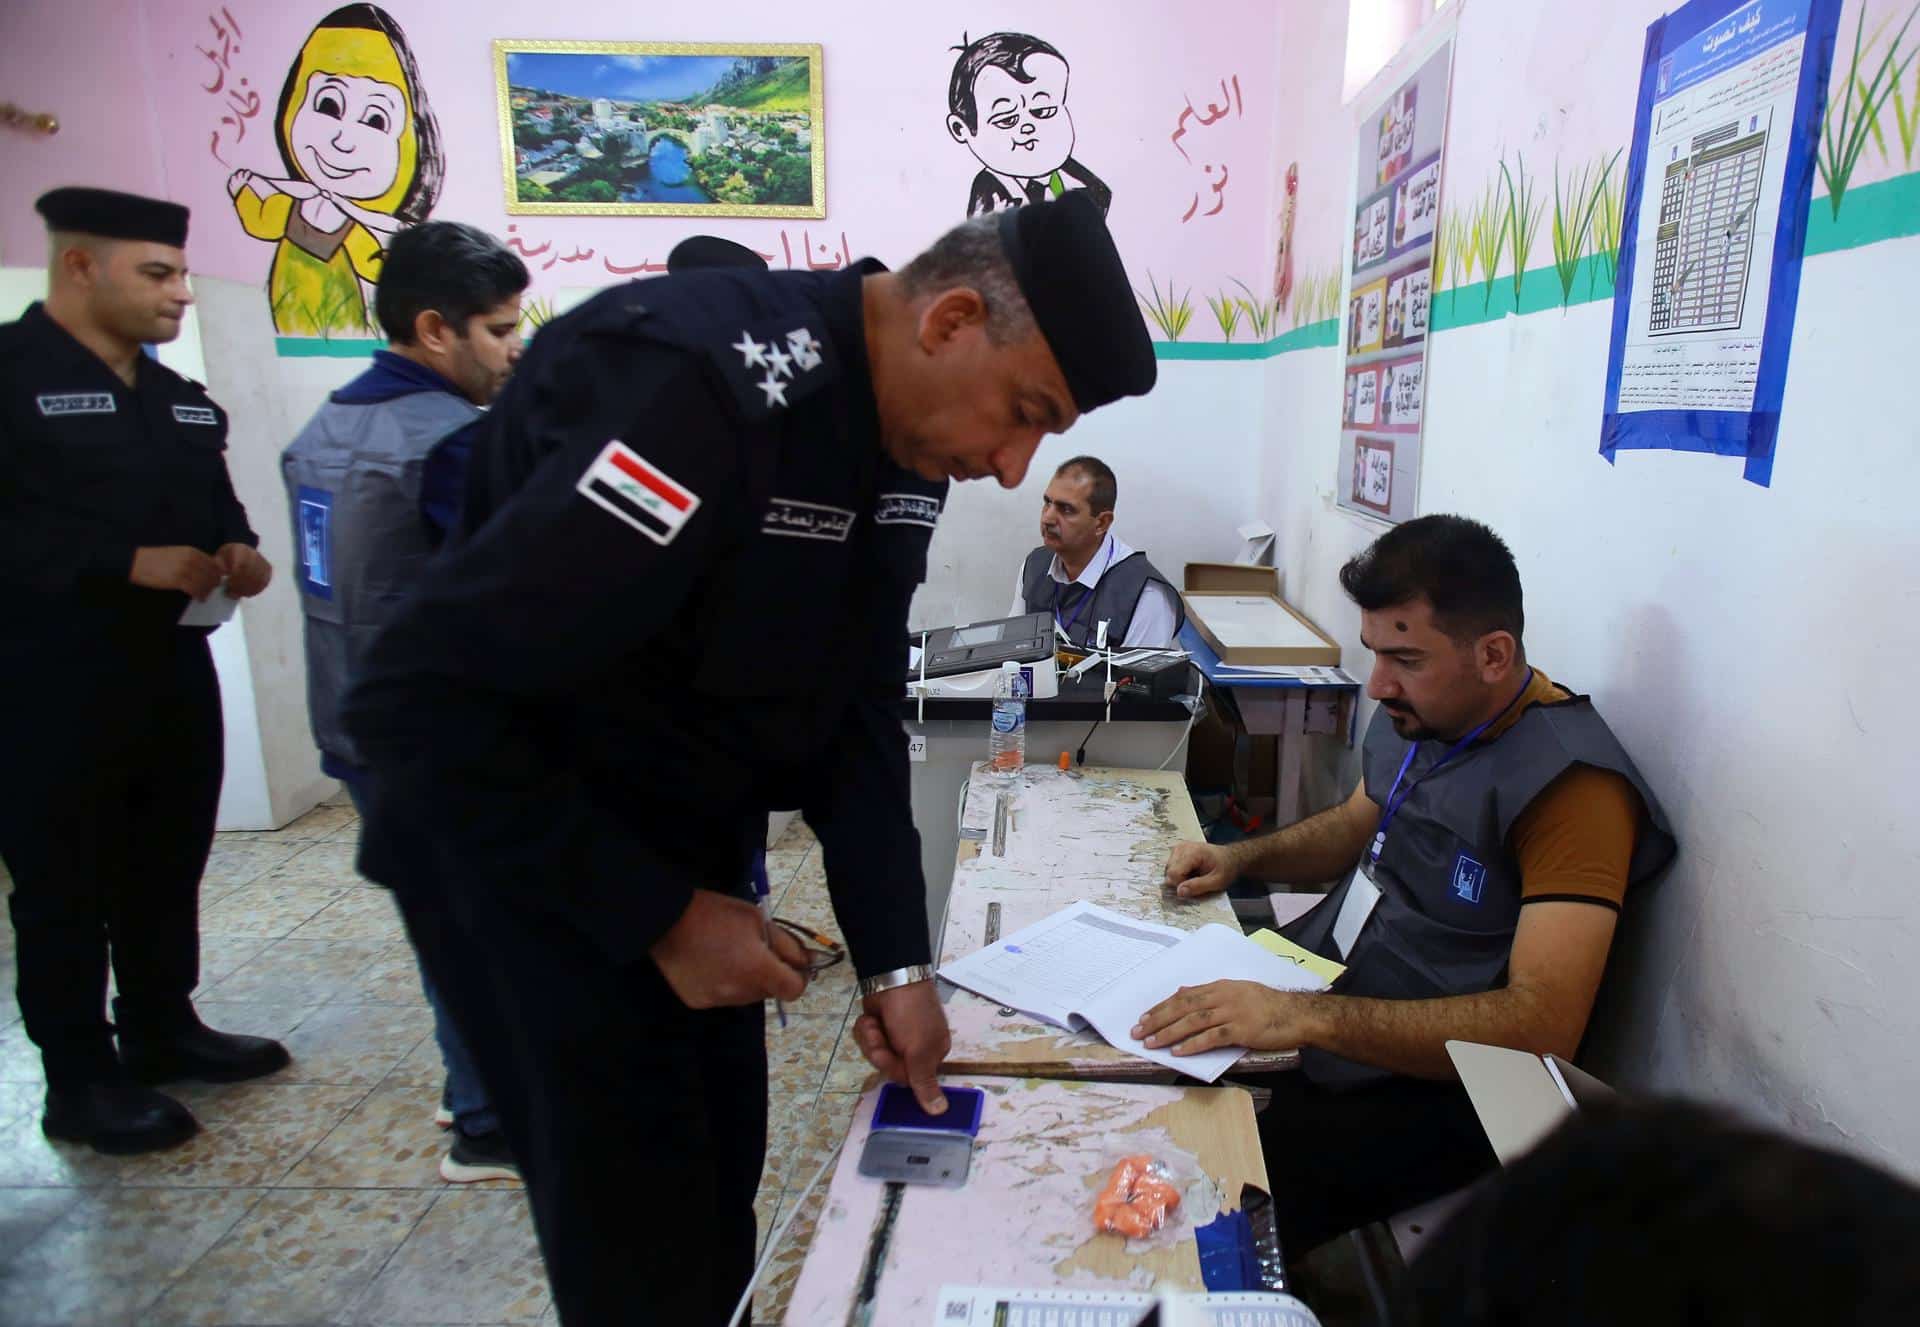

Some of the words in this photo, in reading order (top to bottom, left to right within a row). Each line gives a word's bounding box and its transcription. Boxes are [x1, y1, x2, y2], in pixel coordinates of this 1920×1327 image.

[1739, 4, 1762, 33] كيف
[195, 6, 241, 94] الجهل
[1702, 20, 1736, 53] تصوت
[207, 77, 260, 169] ظلام
[1171, 73, 1242, 166] العلم
[1181, 163, 1228, 224] نور
[781, 506, 815, 527] نعمة
[810, 515, 849, 533] عامر
[910, 743, 923, 753] 47
